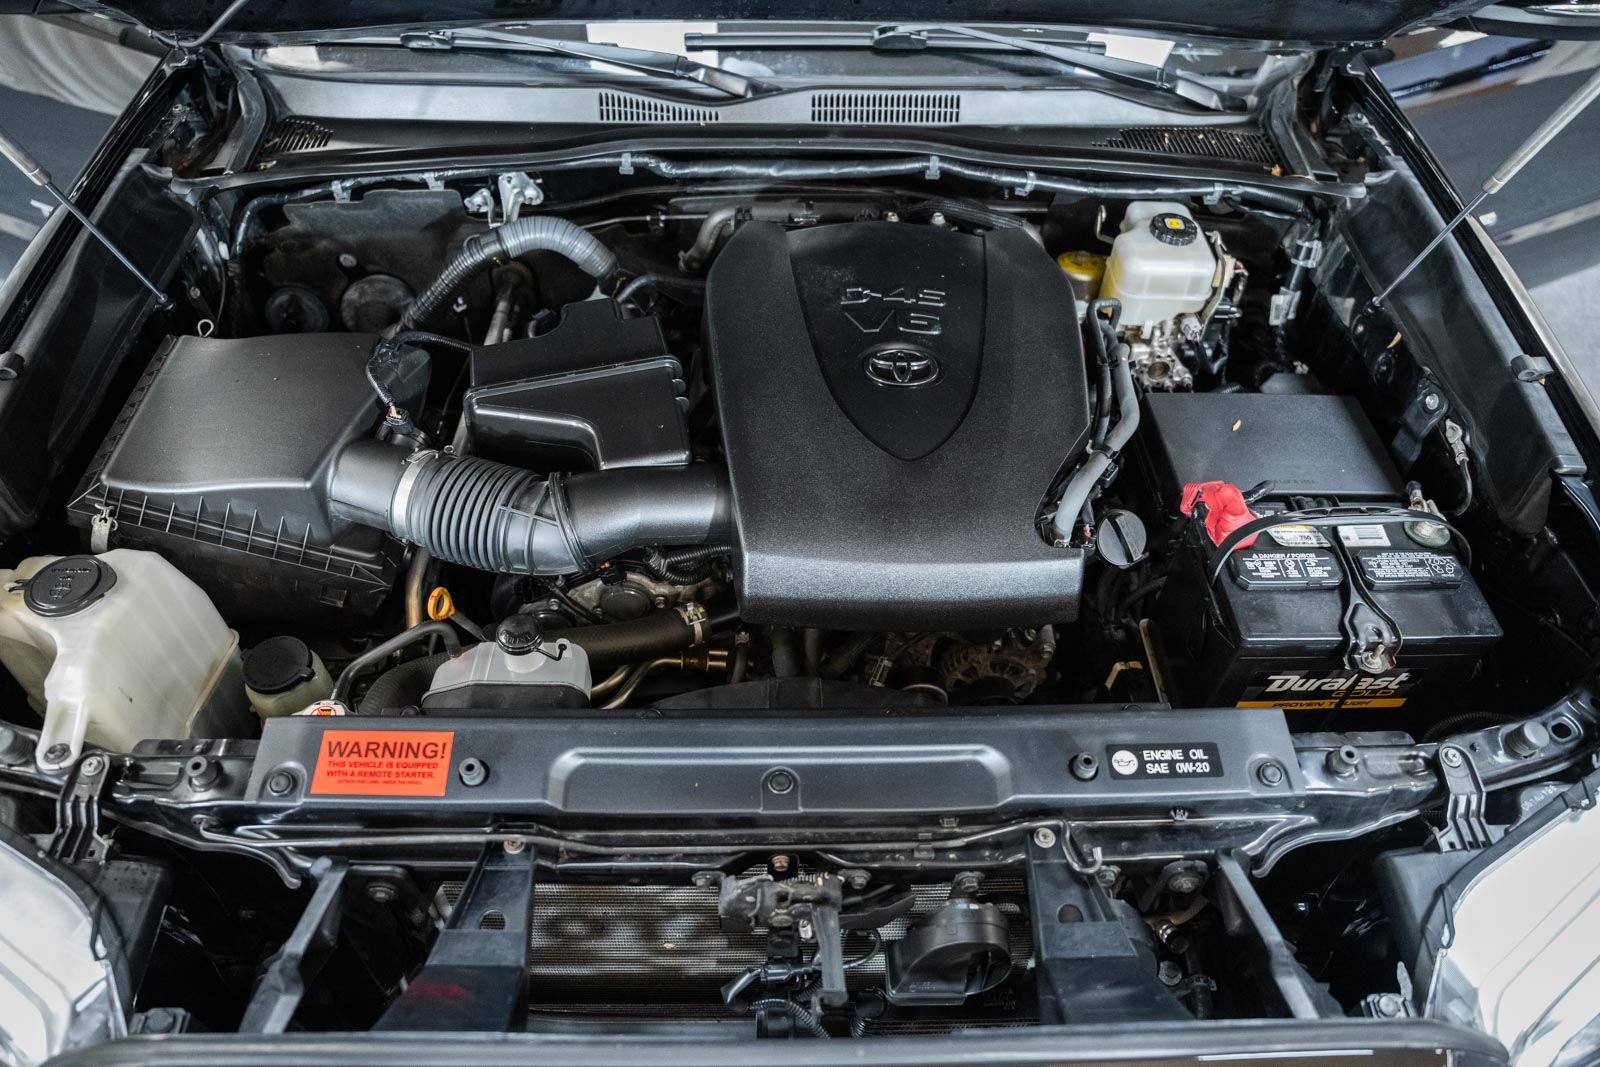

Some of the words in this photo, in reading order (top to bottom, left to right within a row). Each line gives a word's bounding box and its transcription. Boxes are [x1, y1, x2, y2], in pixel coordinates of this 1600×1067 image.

[844, 310, 941, 335] V6
[328, 741, 447, 759] WARNING!
[1142, 750, 1184, 761] ENGINE
[1189, 749, 1208, 760] OIL
[349, 761, 384, 769] VEHICLE
[1145, 763, 1170, 774] SAE
[1175, 762, 1210, 773] 0W-20
[395, 771, 434, 779] STARTER.
